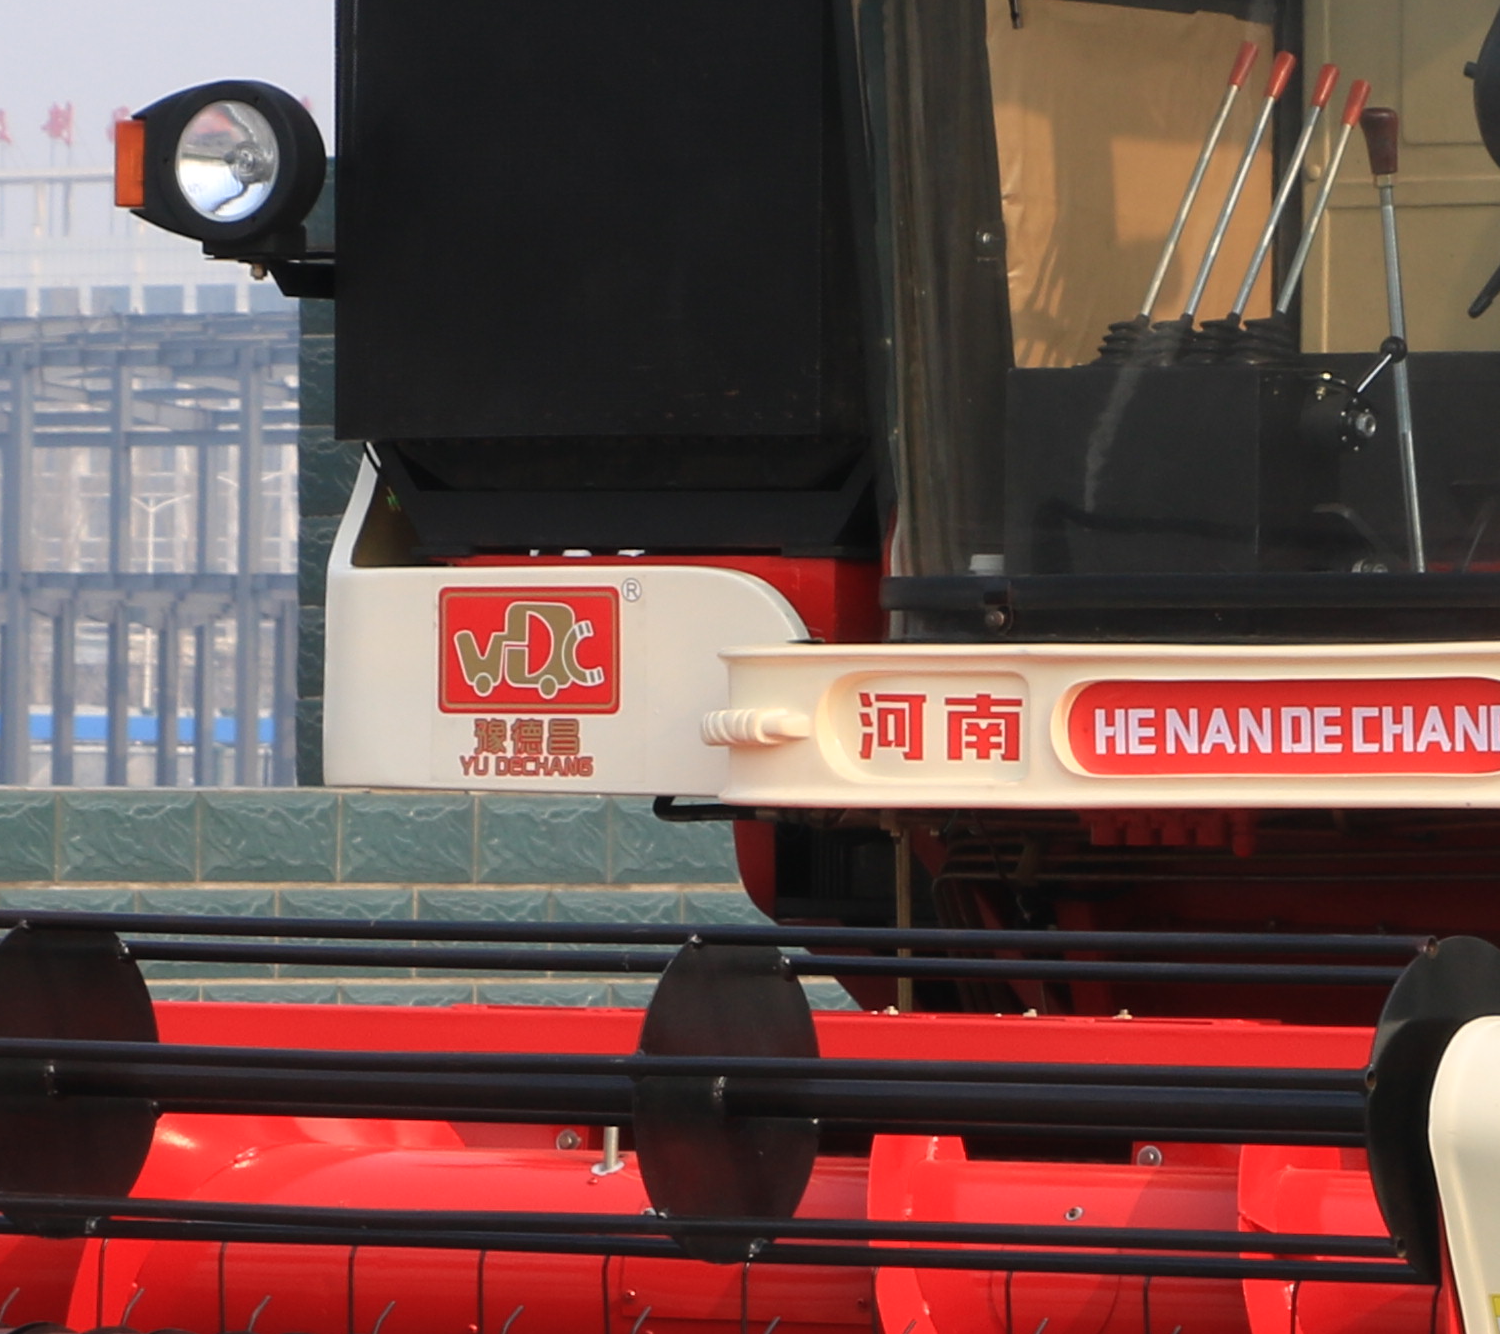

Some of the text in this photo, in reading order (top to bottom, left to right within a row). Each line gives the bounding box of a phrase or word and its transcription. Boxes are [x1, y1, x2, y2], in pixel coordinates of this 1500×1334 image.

[474, 718, 580, 755] 豫德昌
[858, 692, 1024, 761] 河南
